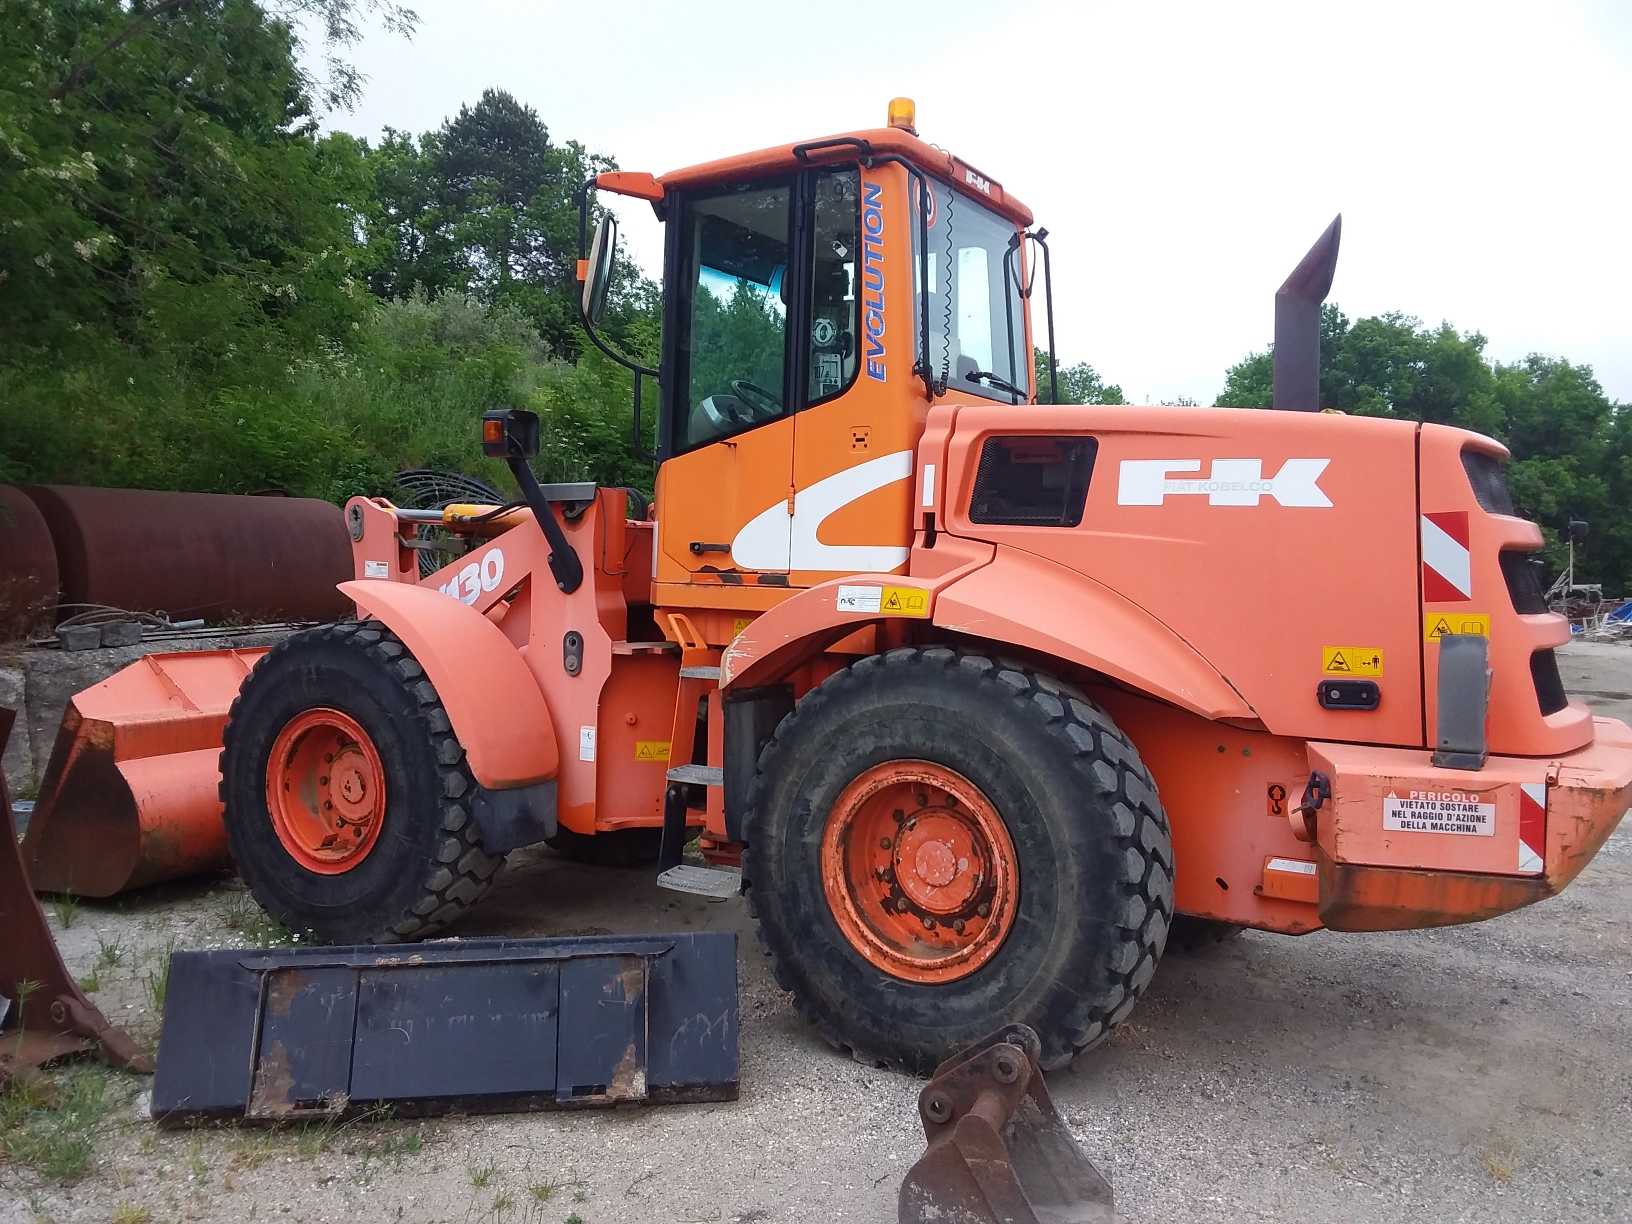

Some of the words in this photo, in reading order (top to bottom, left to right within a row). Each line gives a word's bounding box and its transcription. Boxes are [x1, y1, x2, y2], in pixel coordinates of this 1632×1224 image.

[863, 183, 887, 382] EVOLUTION
[1164, 481, 1194, 493] FIAT
[1198, 481, 1273, 493] KOBELCO
[1409, 790, 1479, 802] PERICOLO
[1399, 801, 1437, 810] VIETATO
[1439, 803, 1479, 812] SOSTARE
[1391, 810, 1407, 819] NEL
[1410, 812, 1444, 821] RAGGIO
[1446, 814, 1487, 823] D'AZIONE
[1400, 821, 1427, 830] DELLA
[1430, 823, 1477, 833] MACCHINA
